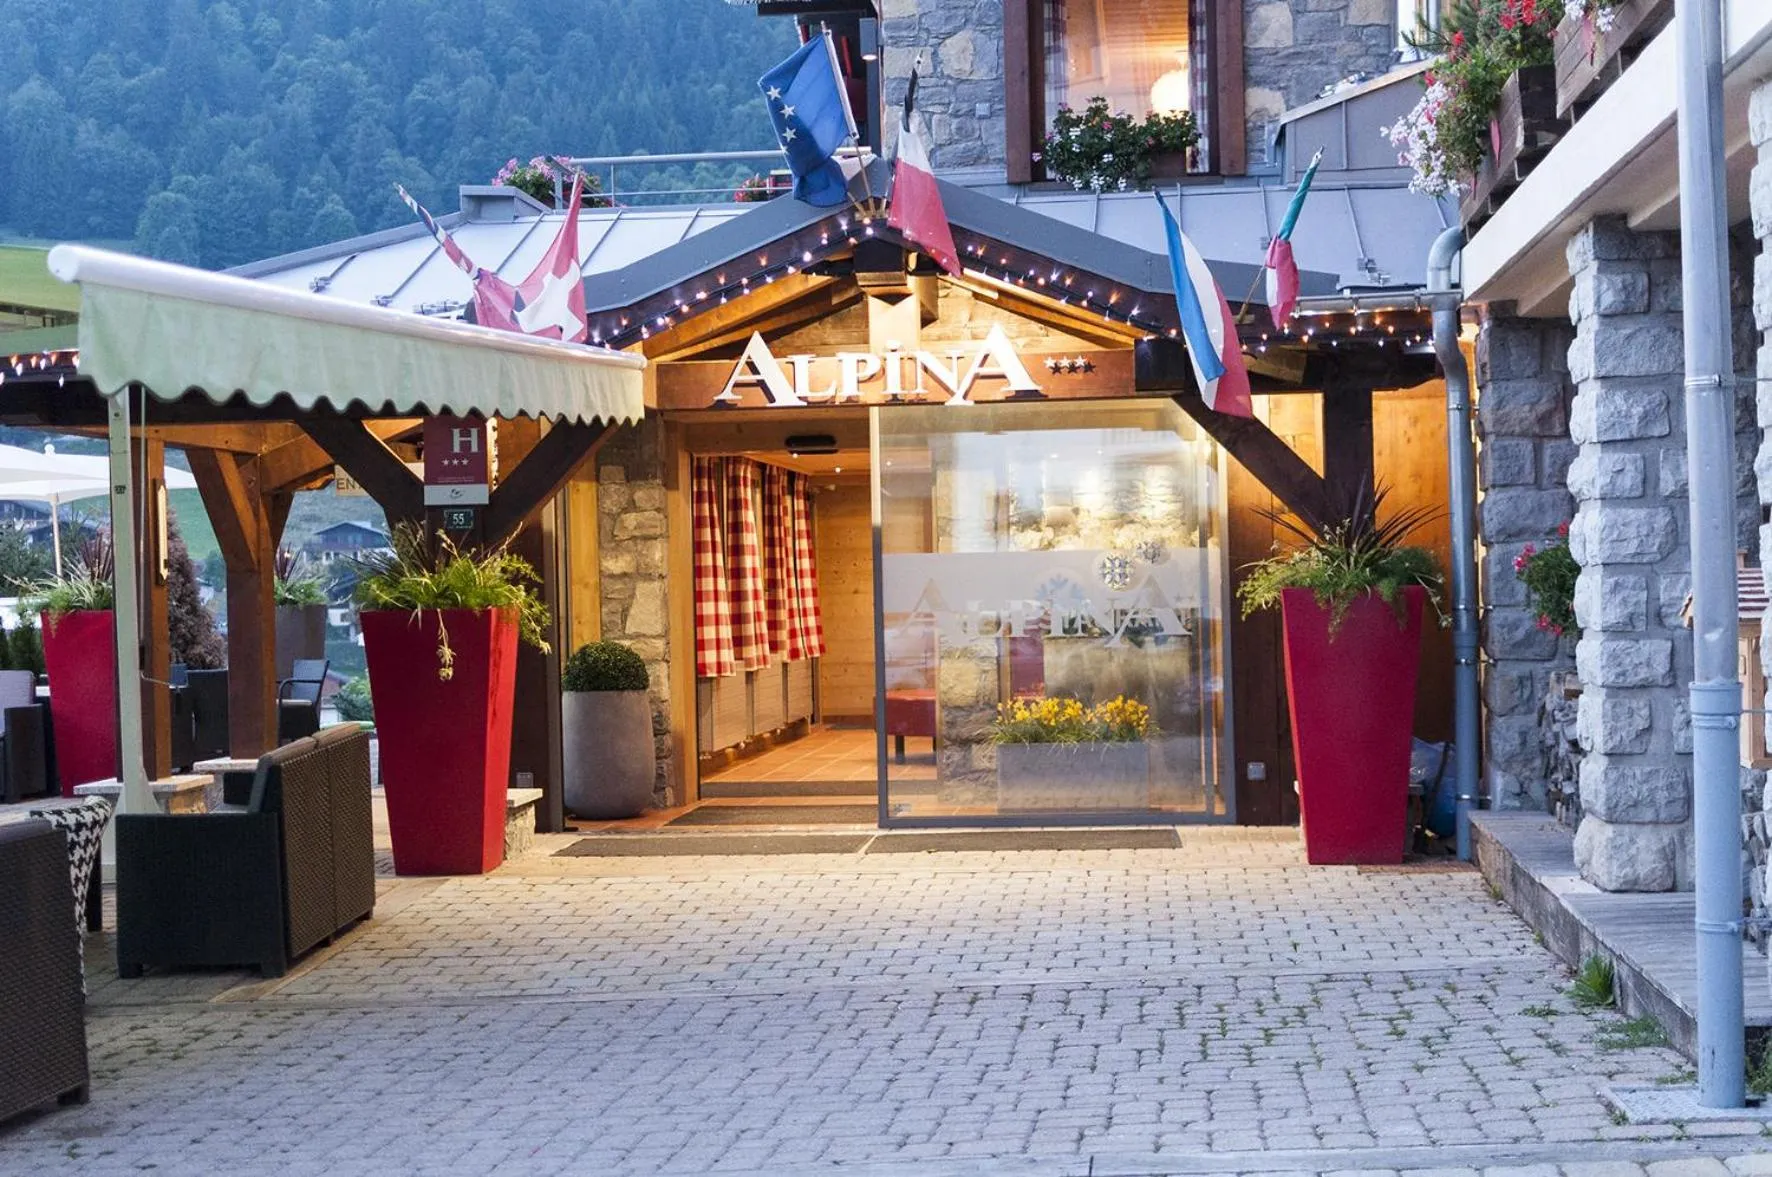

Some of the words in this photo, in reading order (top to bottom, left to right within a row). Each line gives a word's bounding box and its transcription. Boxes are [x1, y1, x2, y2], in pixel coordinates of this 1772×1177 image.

[452, 427, 480, 453] H
[336, 477, 362, 490] EN
[452, 513, 465, 525] 55
